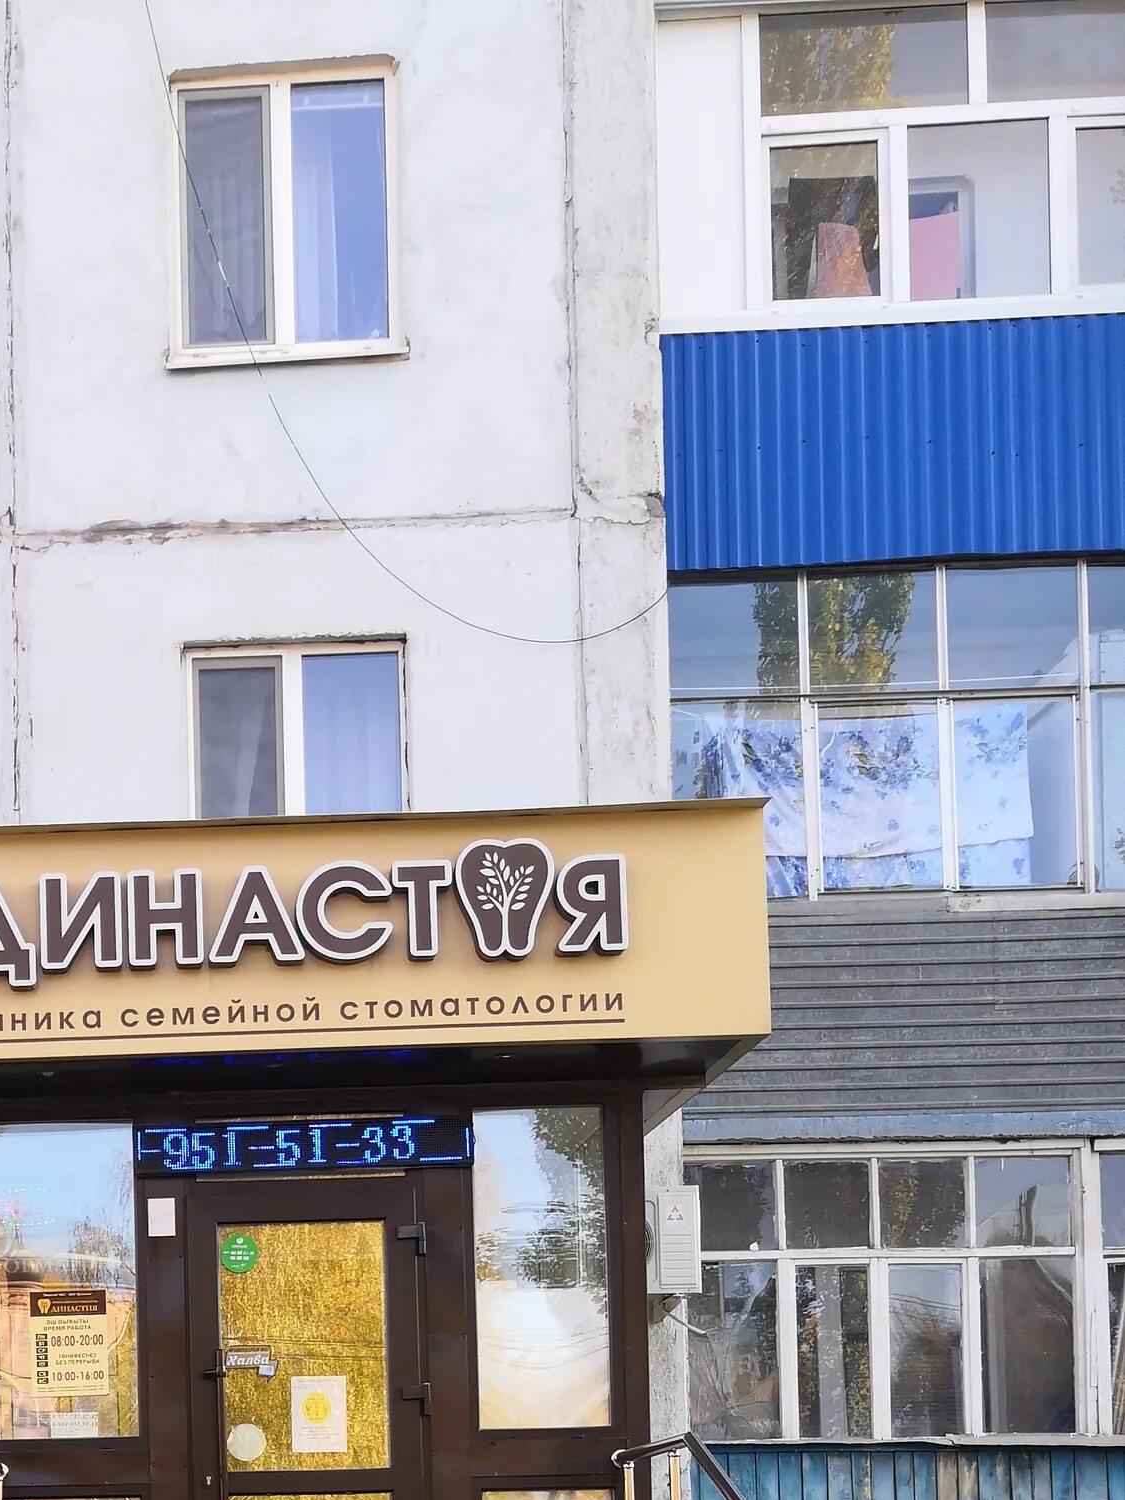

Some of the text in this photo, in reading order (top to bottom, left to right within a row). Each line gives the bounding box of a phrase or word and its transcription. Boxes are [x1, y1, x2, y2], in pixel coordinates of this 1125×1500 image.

[121, 997, 321, 1028] семейной
[340, 992, 623, 1021] стоматологии
[51, 1334, 104, 1347] 08:00-20:00
[52, 1371, 104, 1382] 10:00-16:00
